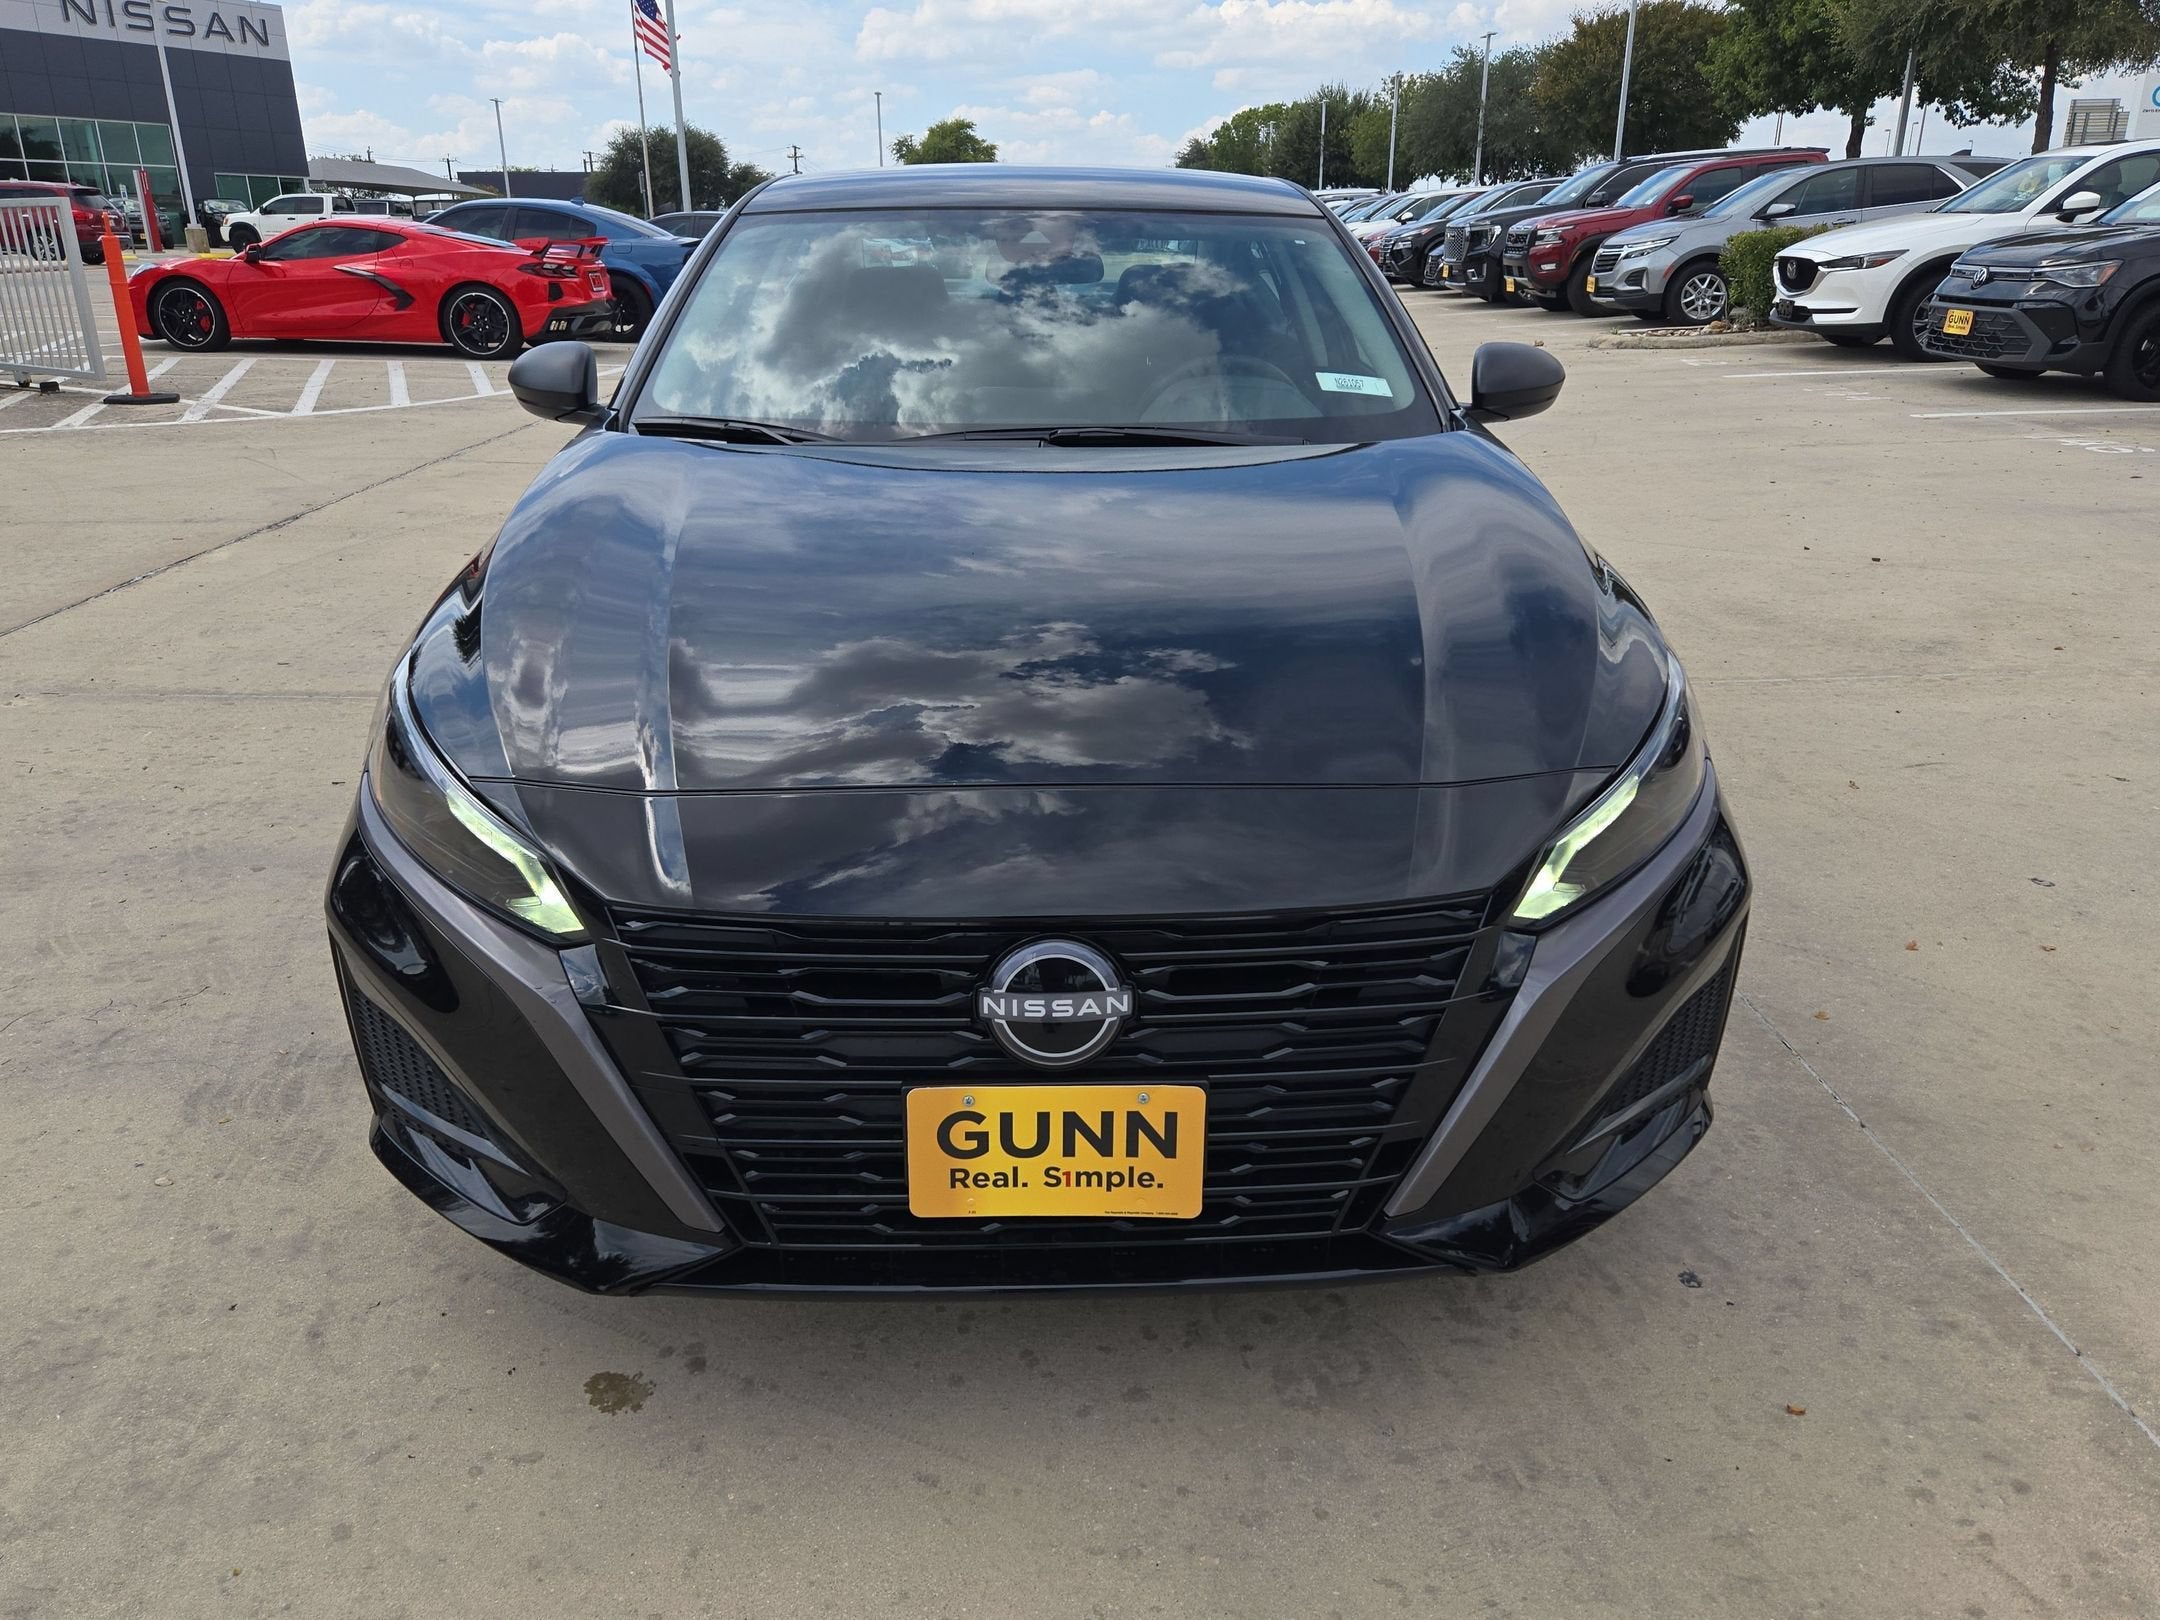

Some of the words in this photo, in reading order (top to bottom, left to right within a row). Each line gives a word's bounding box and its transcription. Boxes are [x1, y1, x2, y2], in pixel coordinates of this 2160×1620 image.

[62, 0, 270, 46] NISSAN
[1949, 314, 1970, 325] GUNN
[983, 994, 1128, 1018] NISSAN
[936, 1110, 1178, 1160] GUNN
[949, 1166, 1028, 1189] Real.
